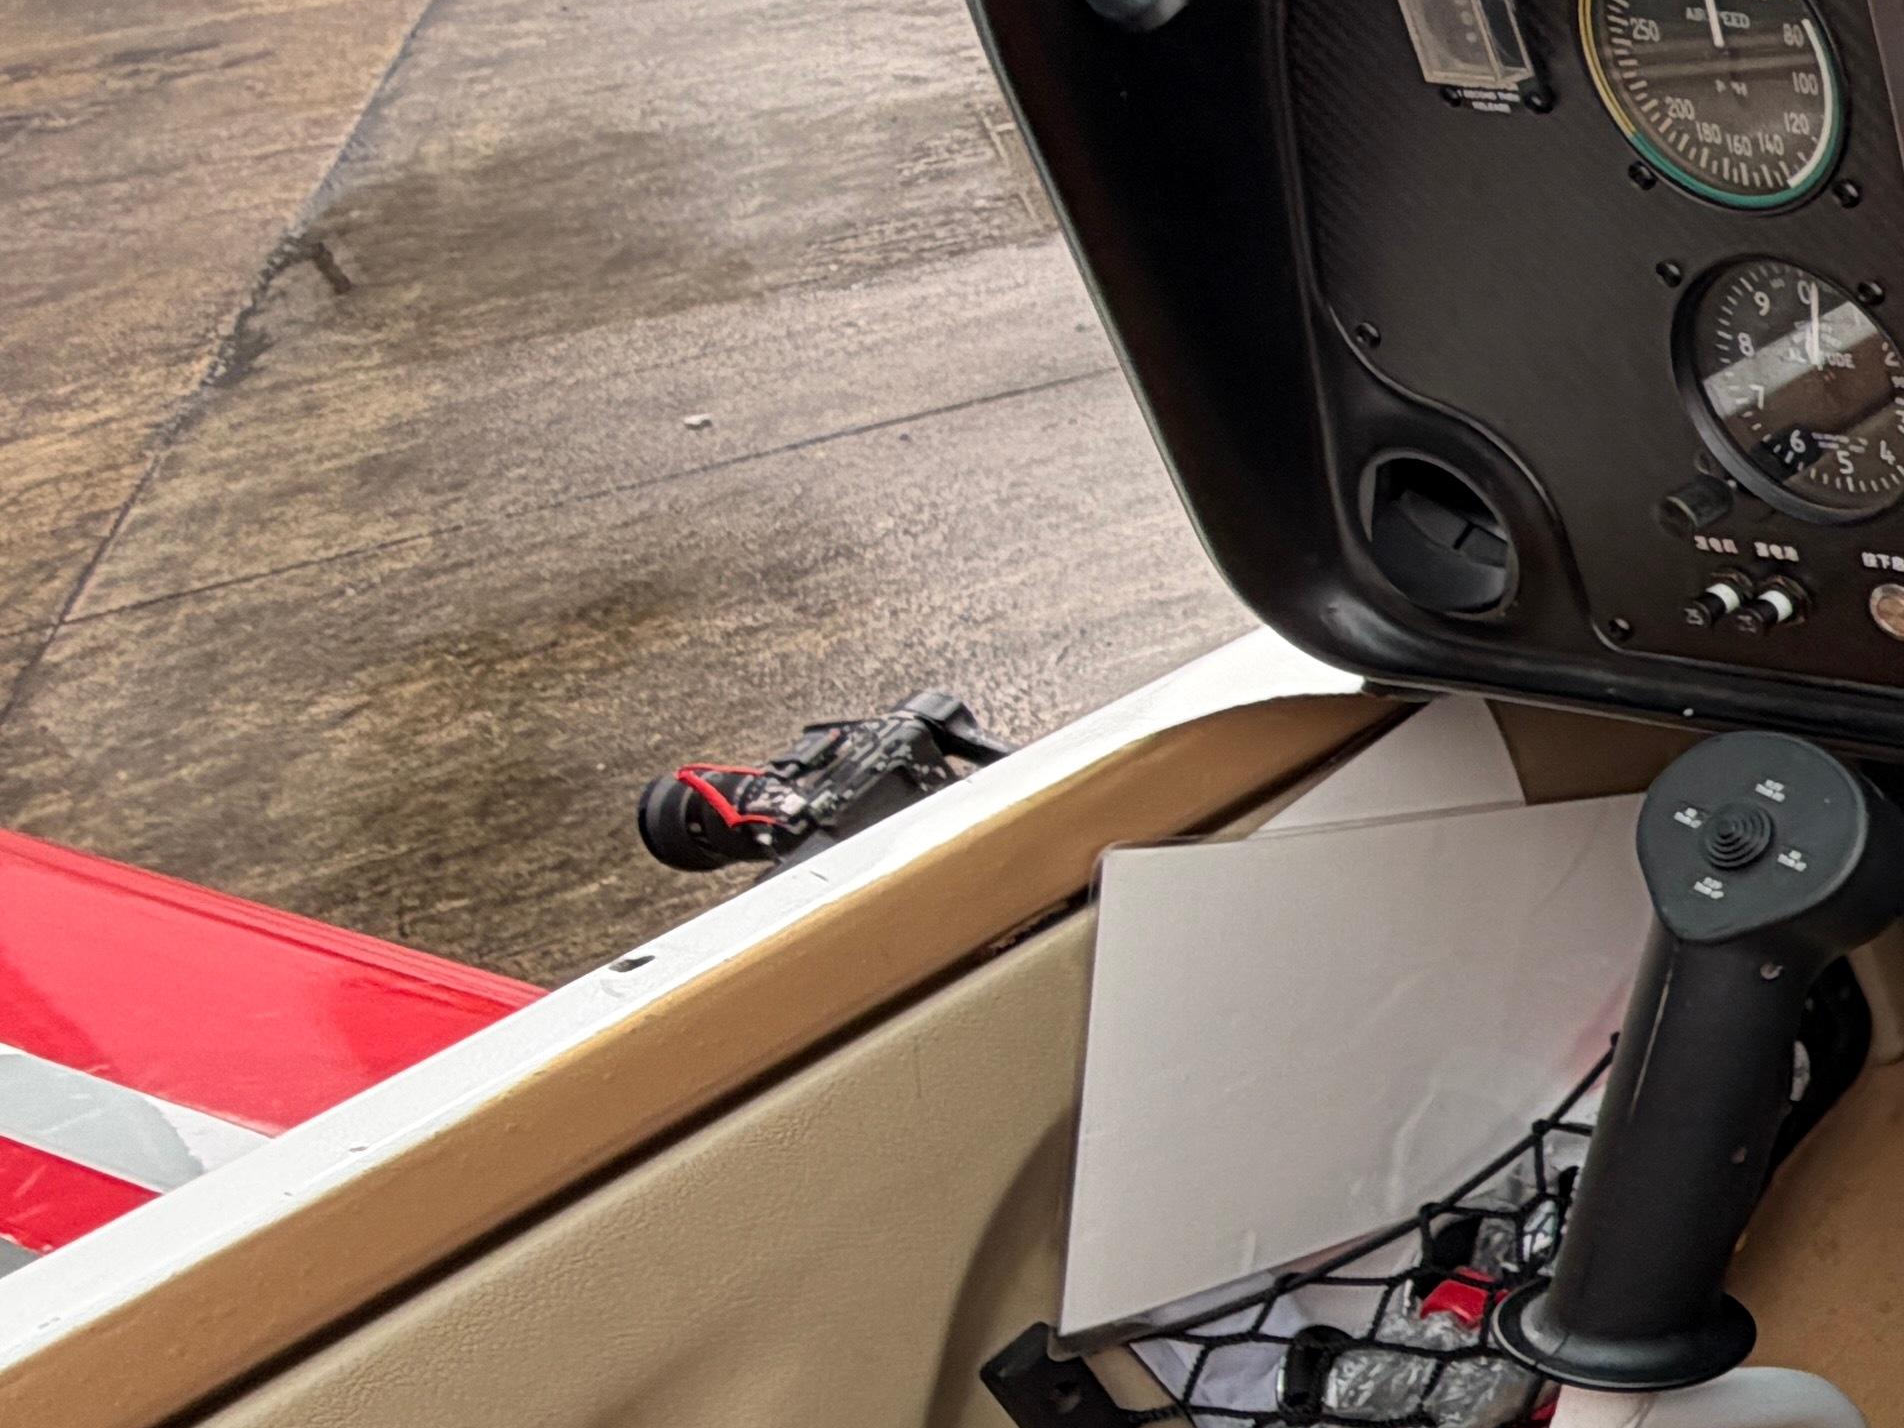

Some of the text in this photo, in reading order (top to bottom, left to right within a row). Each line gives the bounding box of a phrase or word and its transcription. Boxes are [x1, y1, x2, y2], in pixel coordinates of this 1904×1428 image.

[1630, 17, 1661, 42] 250
[1783, 24, 1805, 47] 80
[1793, 72, 1819, 95] 100
[1665, 97, 1695, 121] 200
[1784, 112, 1809, 135] 120
[1753, 291, 1770, 316] 9
[1737, 332, 1755, 357] 8
[1749, 384, 1764, 410] 7
[1789, 429, 1806, 454] 6
[1879, 440, 1896, 466] 4
[1837, 450, 1854, 475] 5
